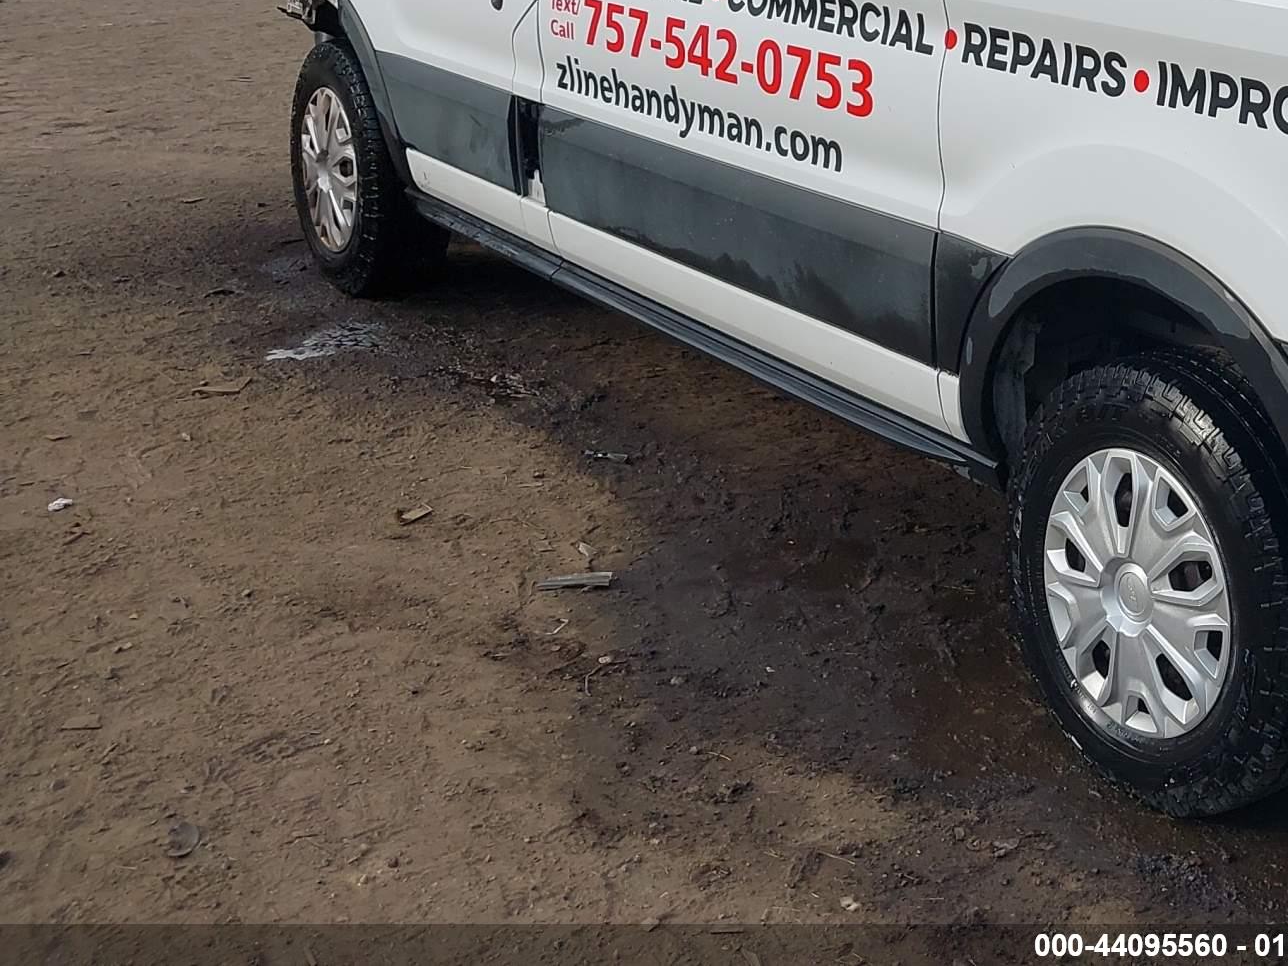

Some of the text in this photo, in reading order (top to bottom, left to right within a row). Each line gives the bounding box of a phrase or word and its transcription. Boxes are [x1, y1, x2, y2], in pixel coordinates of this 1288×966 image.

[550, 19, 575, 41] Call
[962, 23, 1127, 97] REPAIRS
[556, 58, 843, 173] zlinehandyman.com
